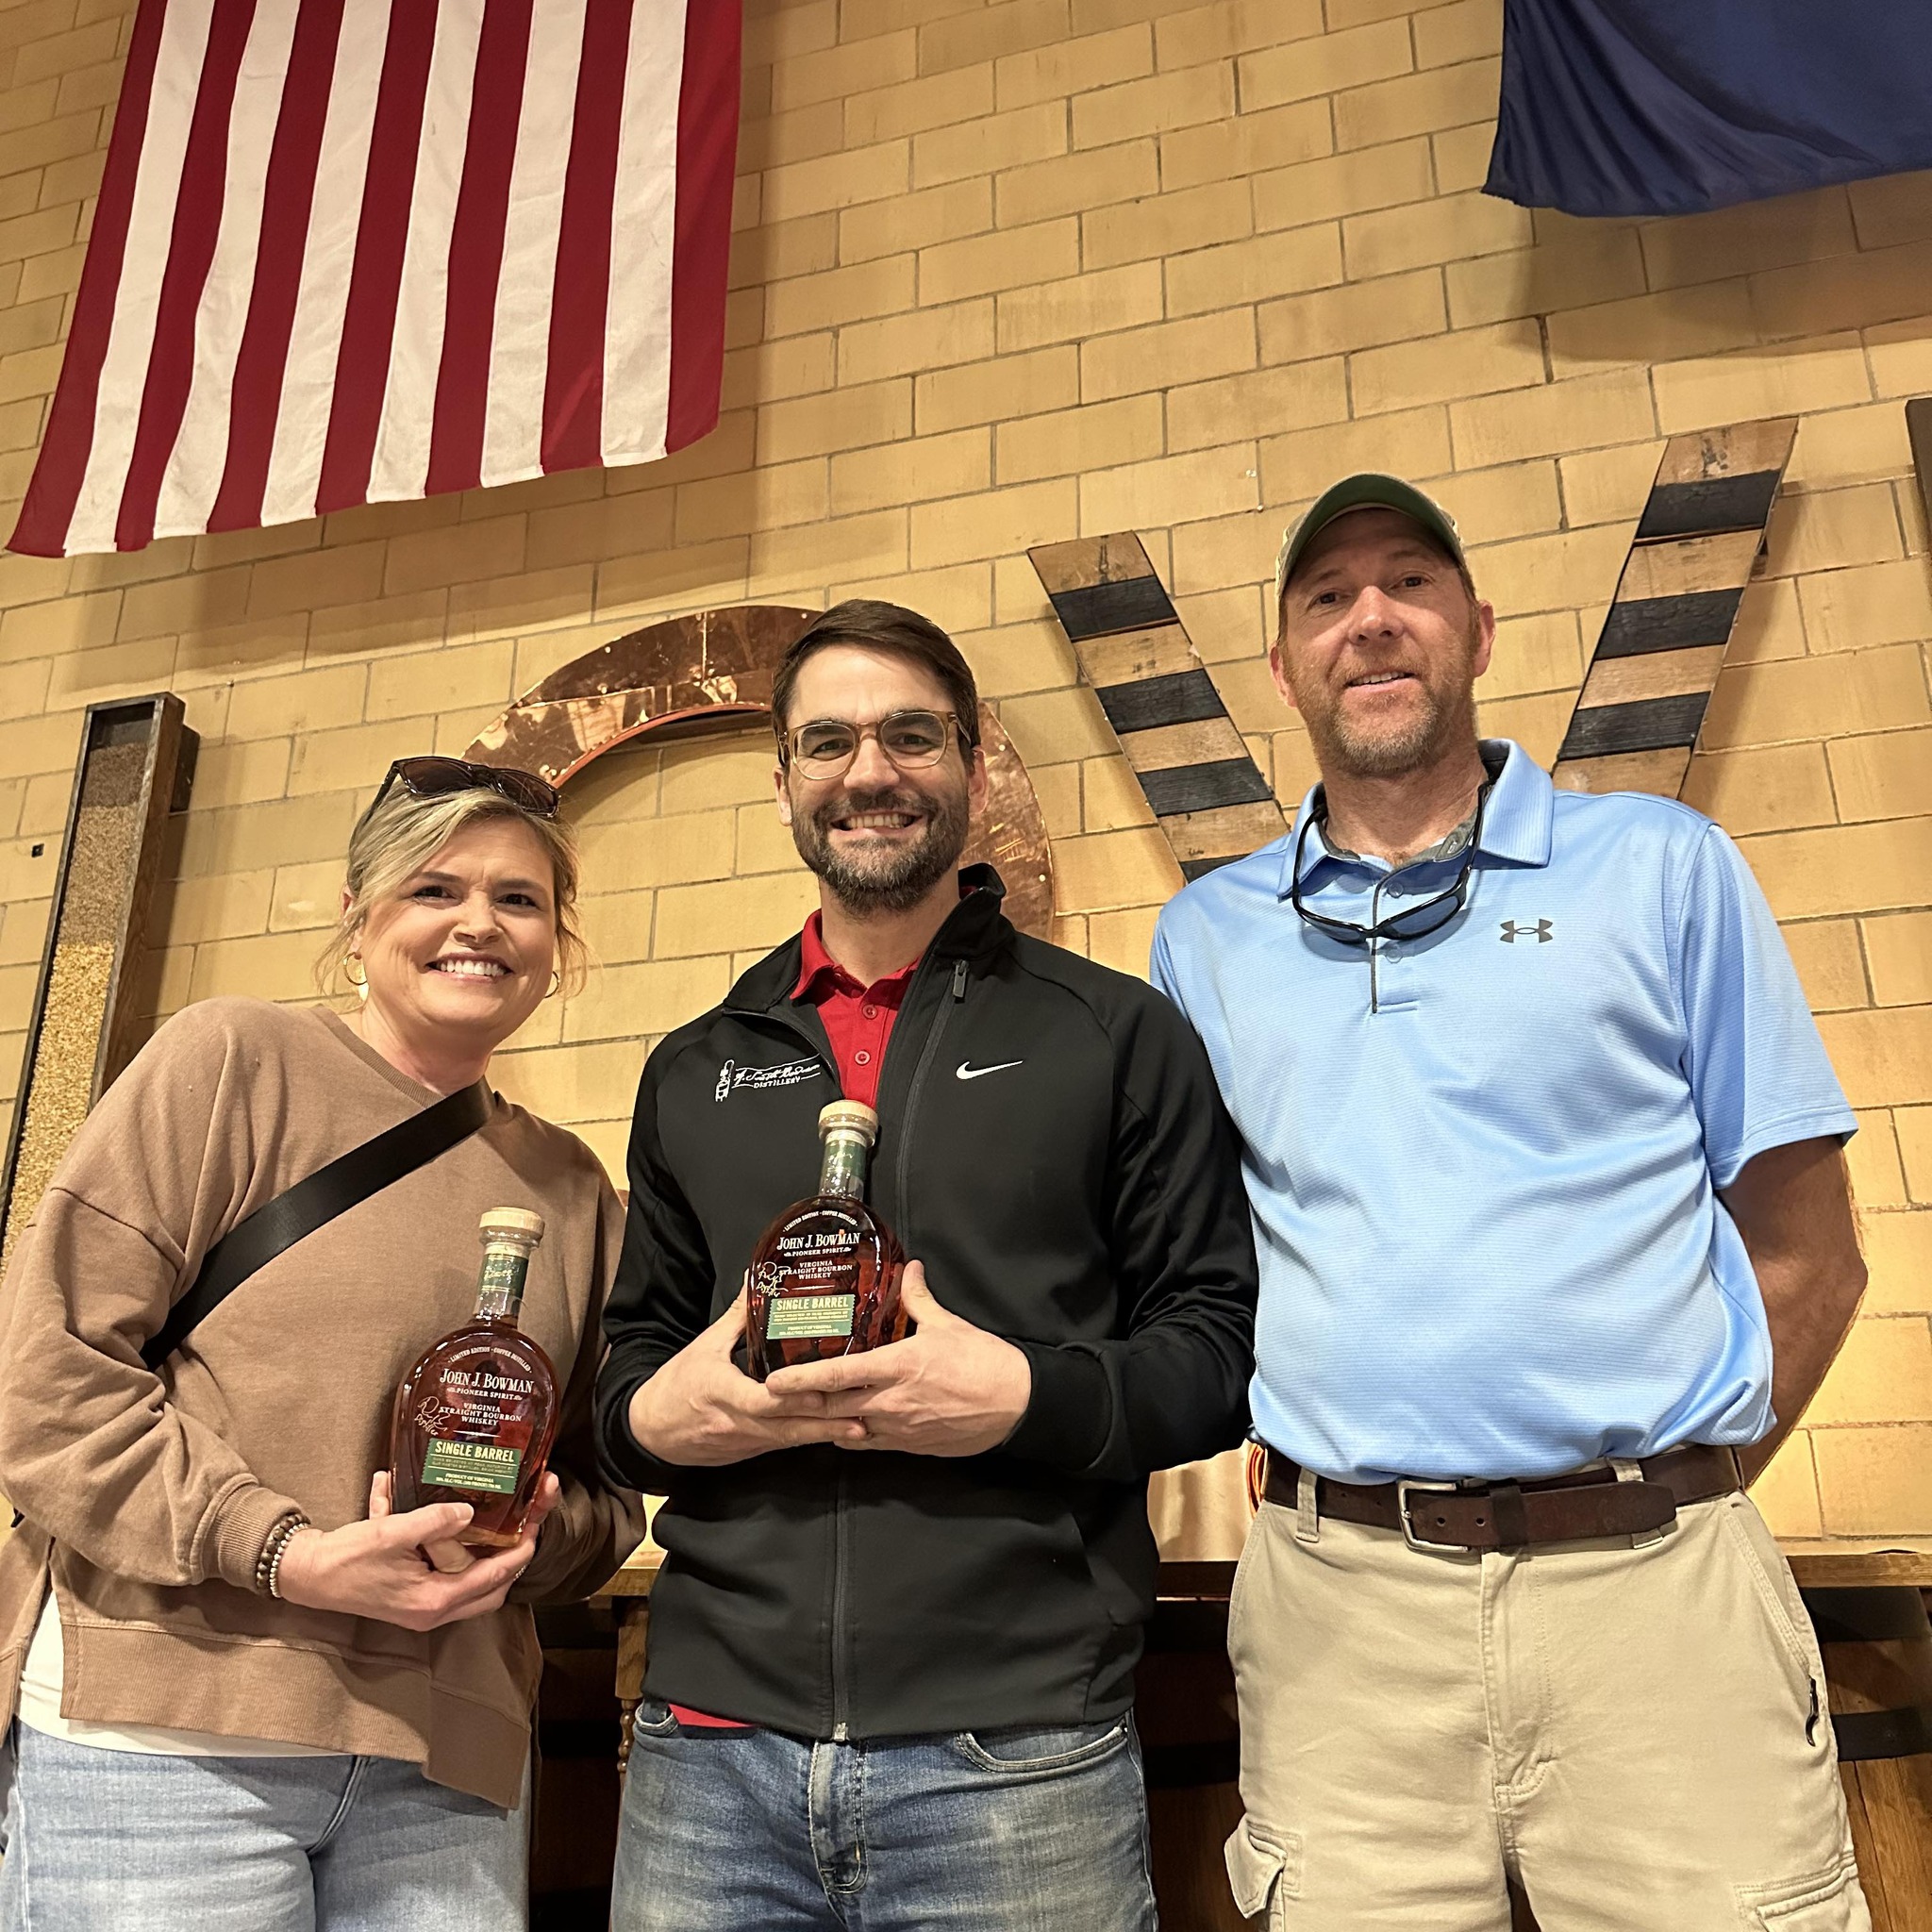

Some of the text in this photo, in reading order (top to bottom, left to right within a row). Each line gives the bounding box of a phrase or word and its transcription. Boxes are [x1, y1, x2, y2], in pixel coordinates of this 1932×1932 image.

[753, 1075, 801, 1089] DISTILLERY
[776, 1233, 861, 1250] JOHN J. BOWMAN
[776, 1296, 849, 1311] SINGLE BARREL
[450, 1348, 471, 1362] LIMITED
[440, 1368, 534, 1393] JOHN J. BOWMAN
[457, 1388, 514, 1400] PIONEER SPIRIT
[439, 1407, 522, 1422] STRAIGHT BOURBON
[463, 1403, 501, 1412] VIRGINIA
[461, 1416, 499, 1426] WHISKEY
[435, 1441, 514, 1462] SINGLE BARREL
